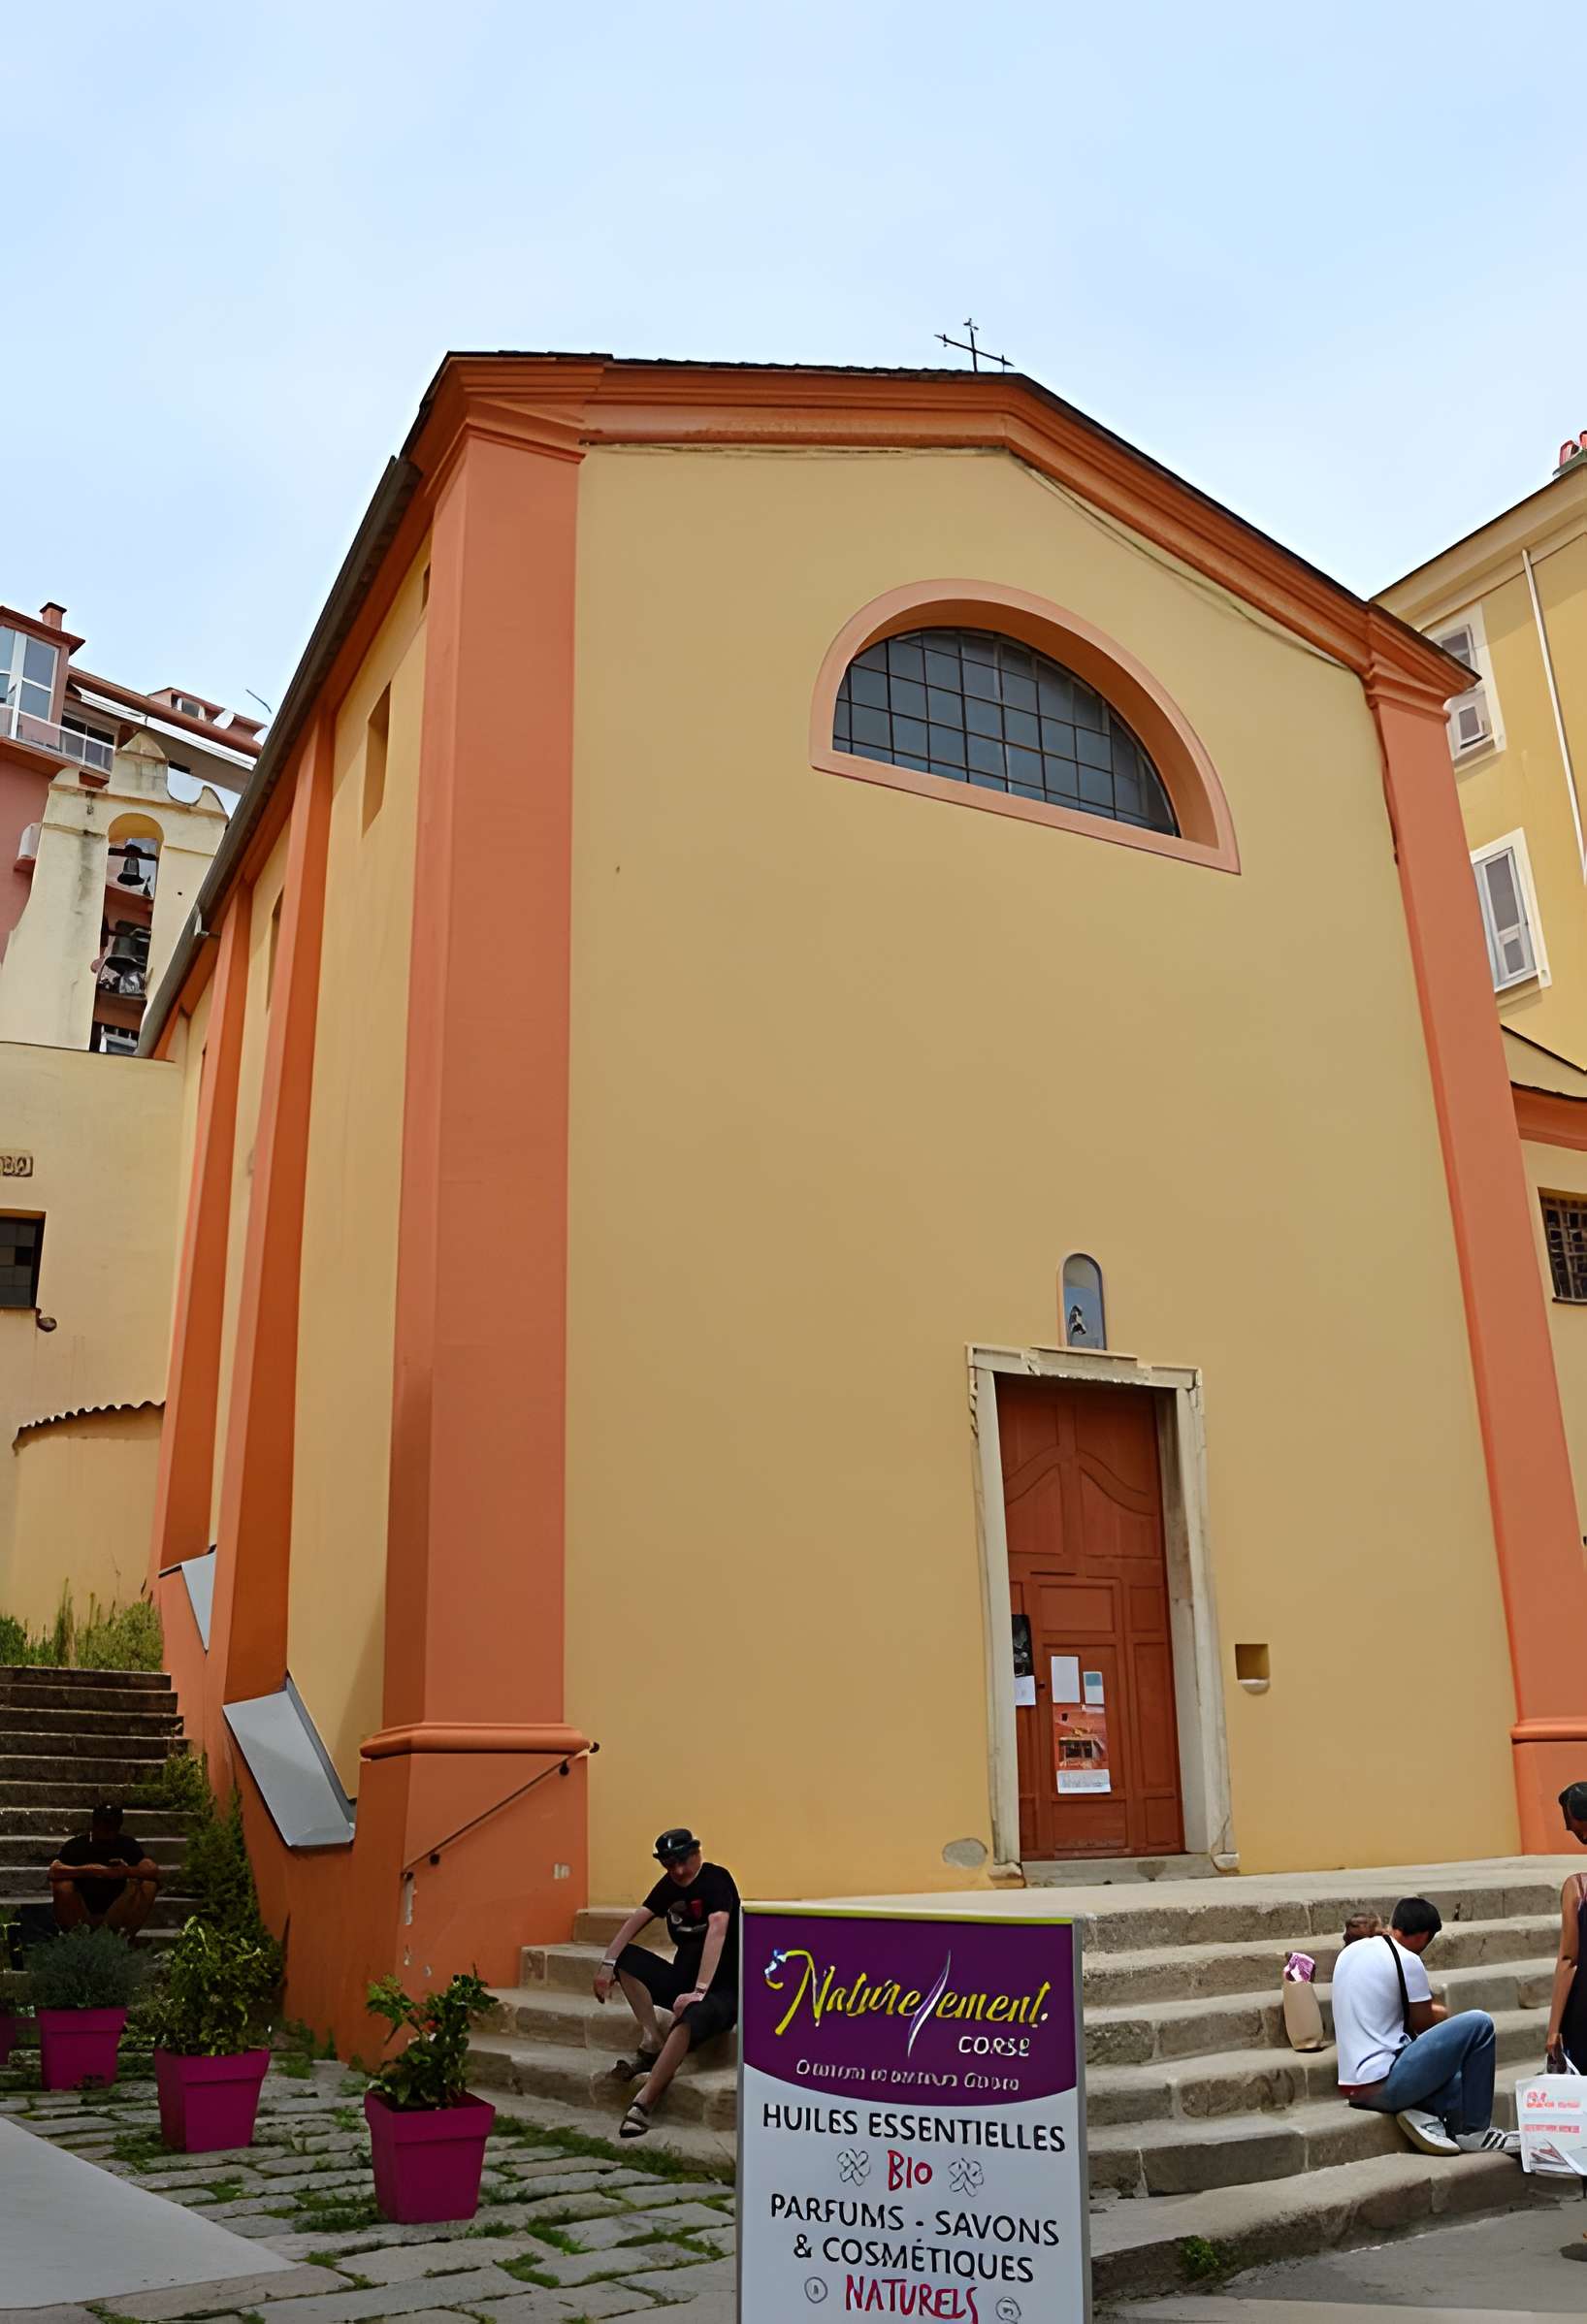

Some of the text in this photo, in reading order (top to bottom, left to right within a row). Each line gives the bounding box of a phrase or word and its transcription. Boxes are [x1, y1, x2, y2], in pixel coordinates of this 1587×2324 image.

[762, 2103, 1066, 2152] HUILES ESSENTIELLES
[771, 2193, 1060, 2246] PARFUMS SAVONS
[794, 2233, 813, 2259] &
[845, 2274, 979, 2324] NATURELS
